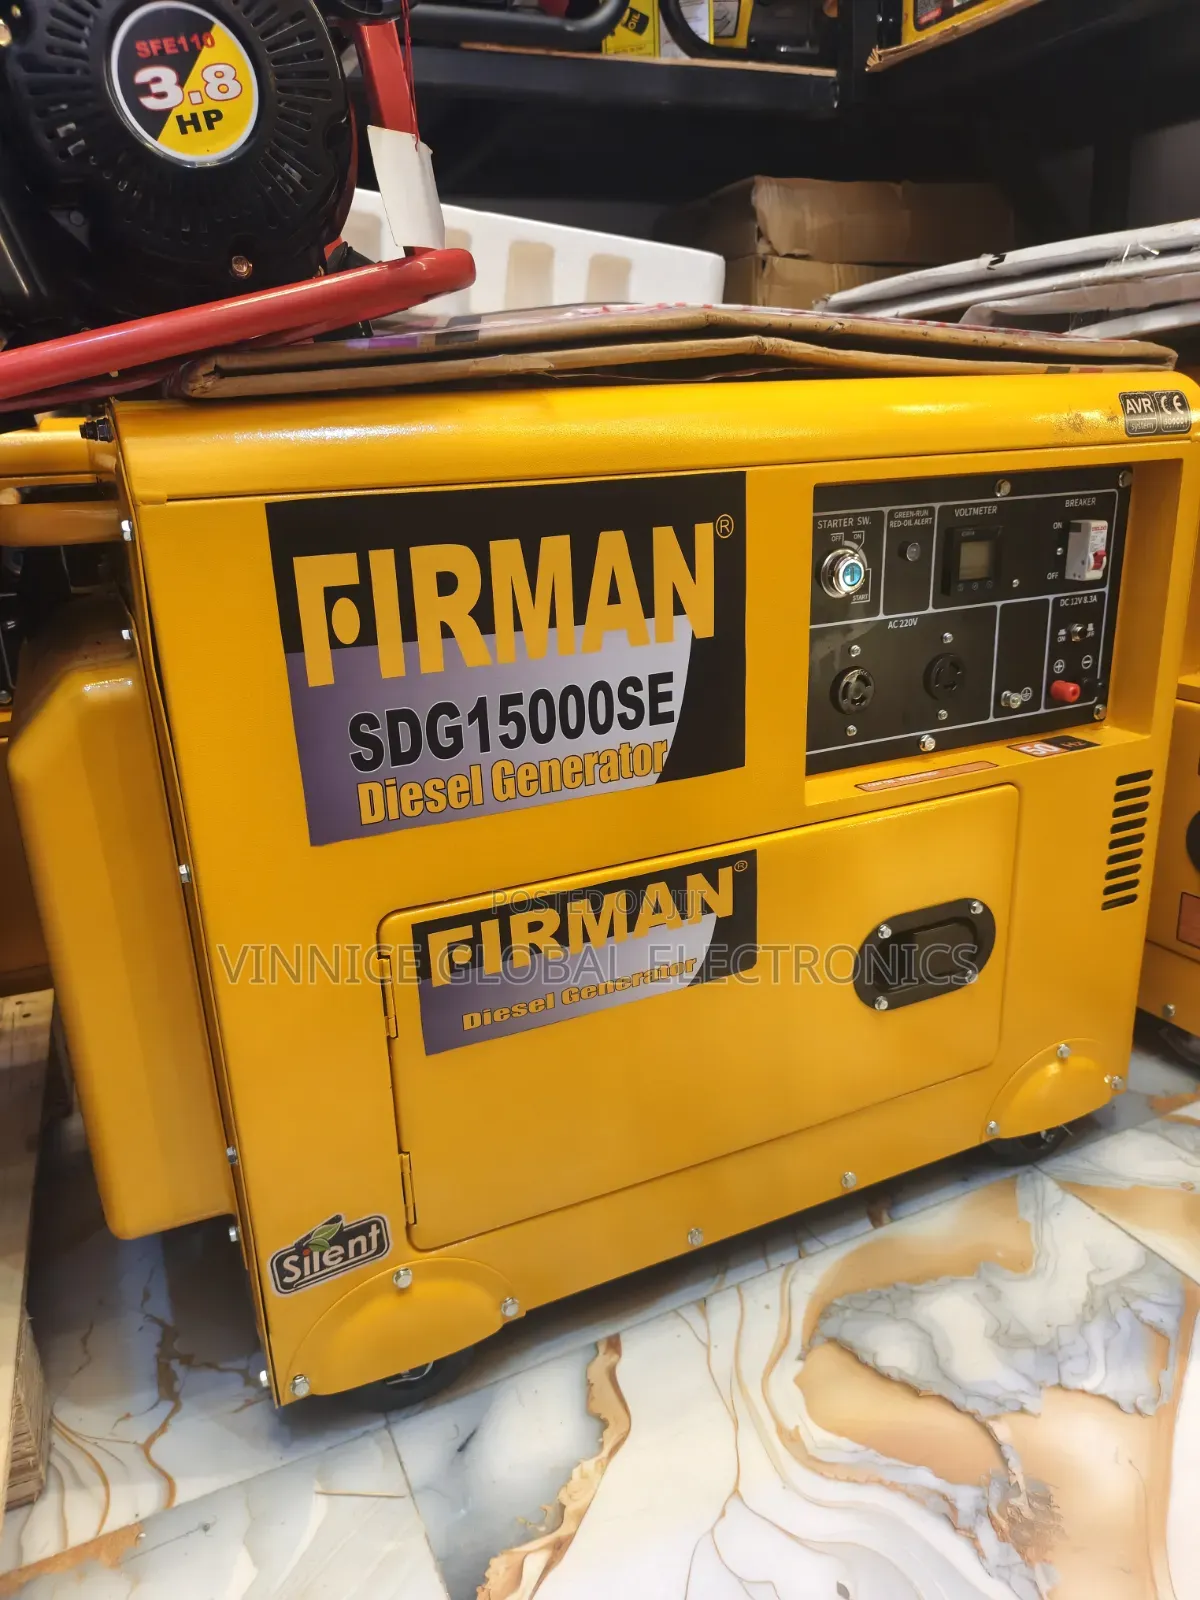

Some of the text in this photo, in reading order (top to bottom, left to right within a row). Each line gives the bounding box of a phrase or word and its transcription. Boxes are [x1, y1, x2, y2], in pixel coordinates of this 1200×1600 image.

[628, 12, 641, 31] OIL
[135, 31, 215, 58] SFE110
[134, 62, 243, 110] 3.8
[175, 109, 224, 135] HP
[1126, 397, 1155, 415] AVR
[1065, 497, 1096, 508] BREAKER
[894, 509, 929, 519] GREEN-RUN
[954, 505, 998, 518] VOLTMETER
[817, 516, 872, 530] STARTER SW.
[889, 517, 933, 528] RED-OIL ALERT
[1053, 521, 1063, 530] ON
[831, 534, 842, 542] OFF
[853, 532, 862, 540] ON
[1046, 571, 1059, 580] OFF
[293, 522, 715, 687] FIRMAN
[852, 593, 869, 602] START
[1060, 598, 1070, 607] DC
[1070, 597, 1083, 606] 12V
[888, 617, 919, 630] AC 220V
[349, 671, 675, 773] SDG15000SE
[1018, 743, 1060, 757] 50
[357, 738, 668, 826] Diesel Generator
[427, 866, 734, 988] FIRMAN
[462, 957, 698, 1031] Diesel Generator
[282, 1223, 381, 1283] Silent
